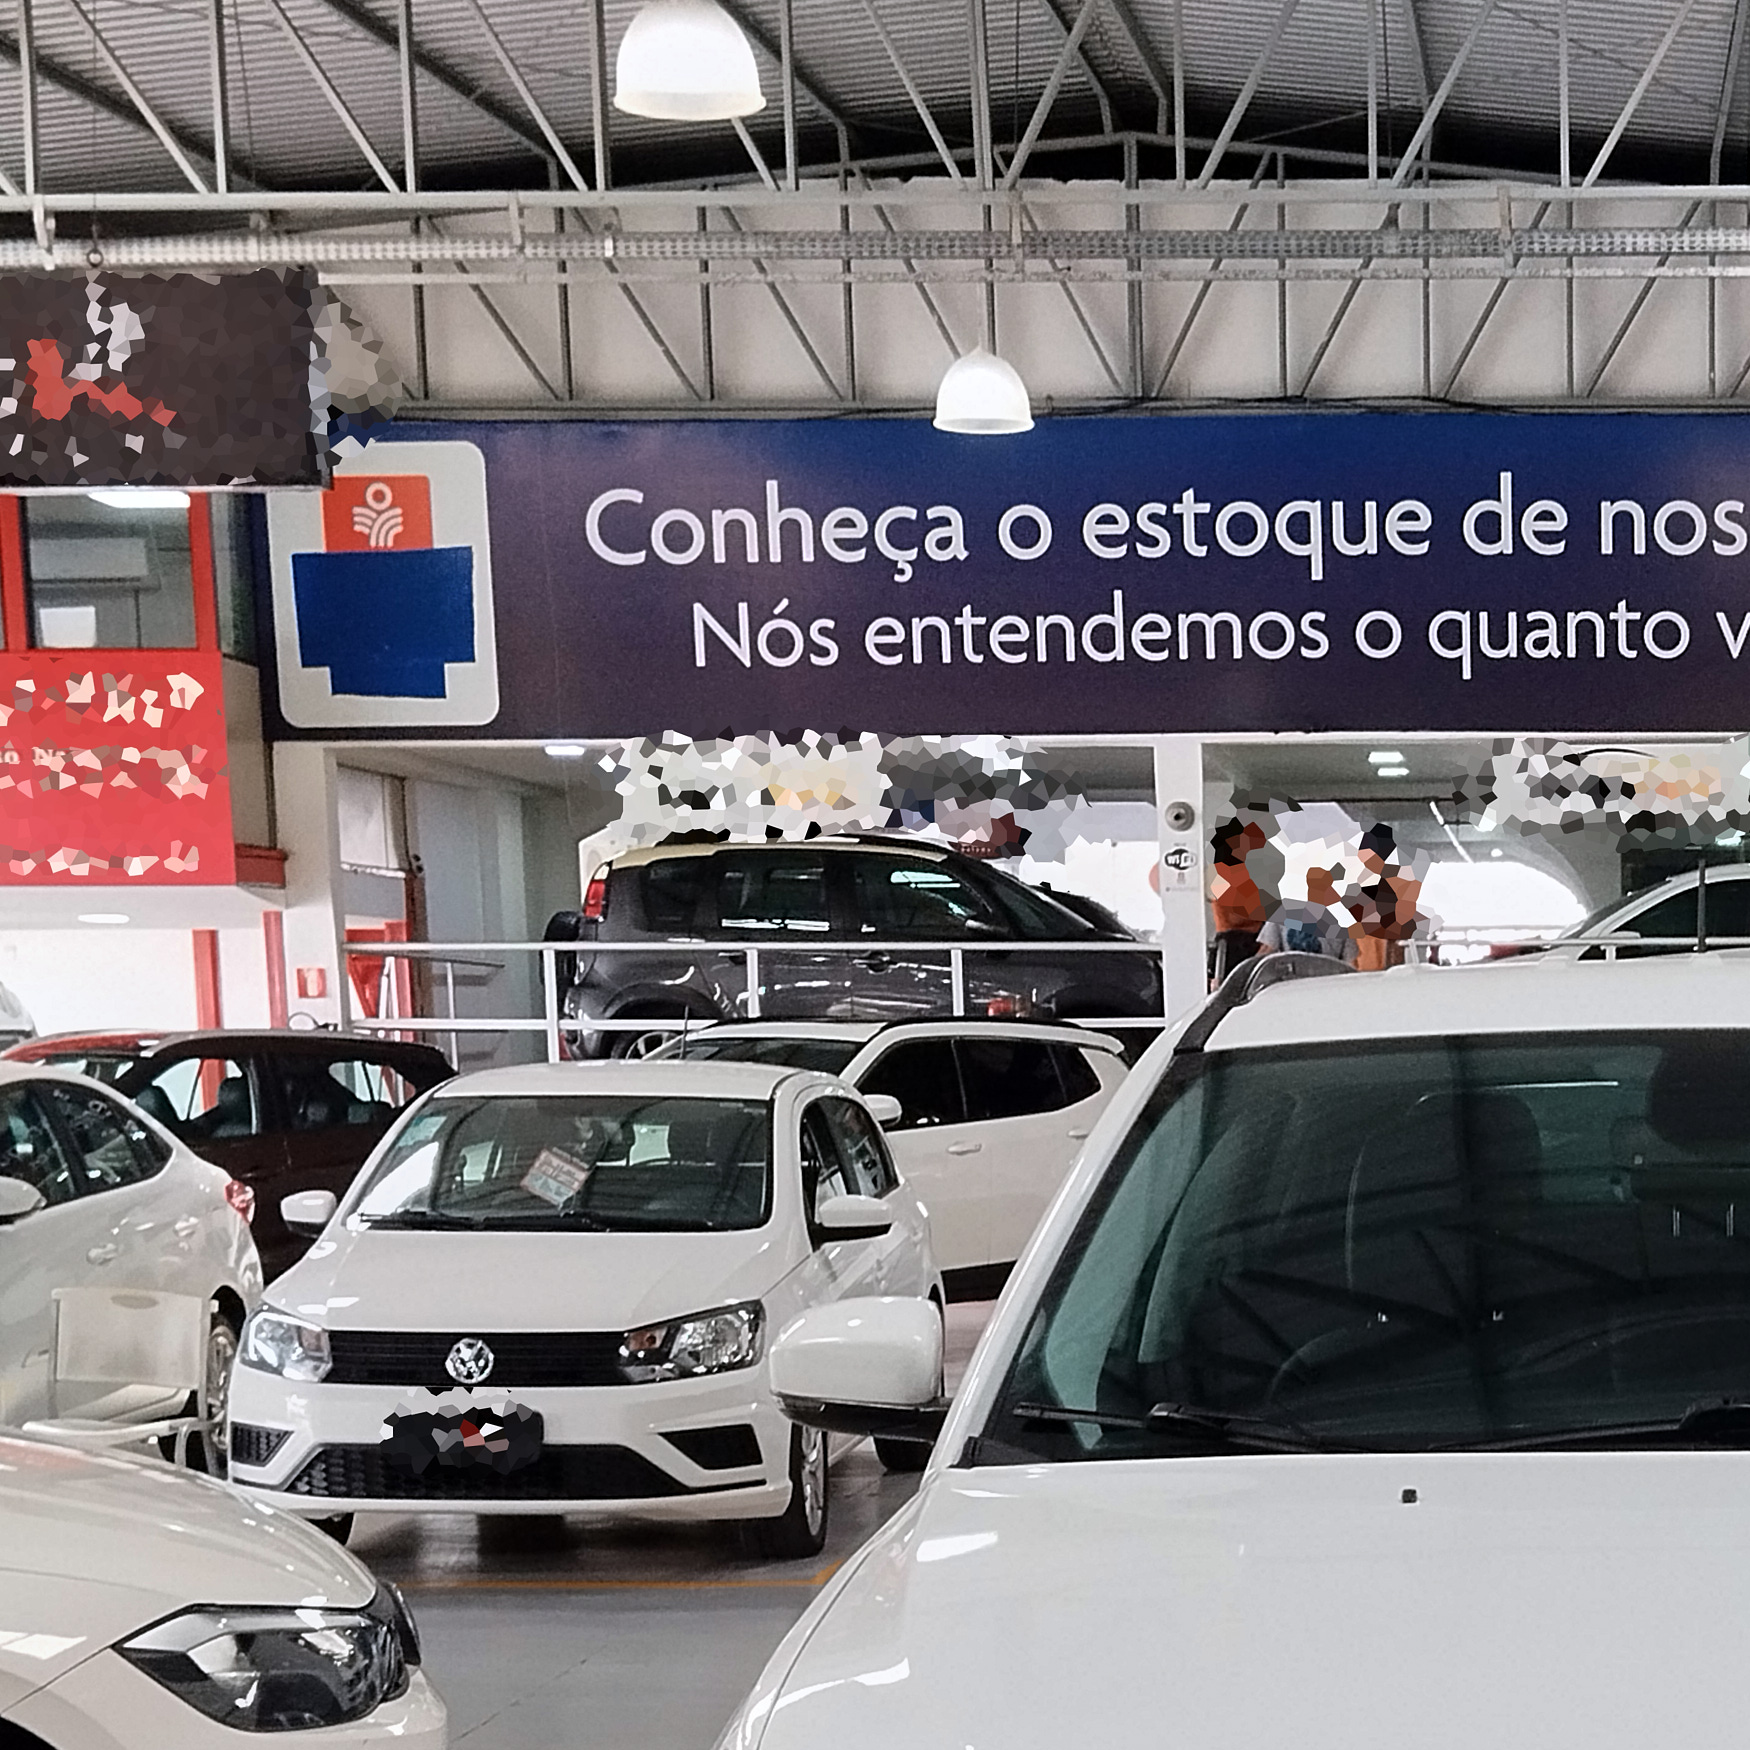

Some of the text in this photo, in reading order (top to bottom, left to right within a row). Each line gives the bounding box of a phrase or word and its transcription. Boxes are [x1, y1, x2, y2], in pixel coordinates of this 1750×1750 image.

[586, 480, 970, 583] Conheça
[998, 503, 1053, 561] o
[1083, 488, 1432, 581] estoque
[1463, 471, 1568, 556] de
[693, 598, 839, 668] Nós
[865, 590, 1329, 666] entendemos
[1356, 611, 1402, 659] o
[1429, 600, 1690, 680] quanto
